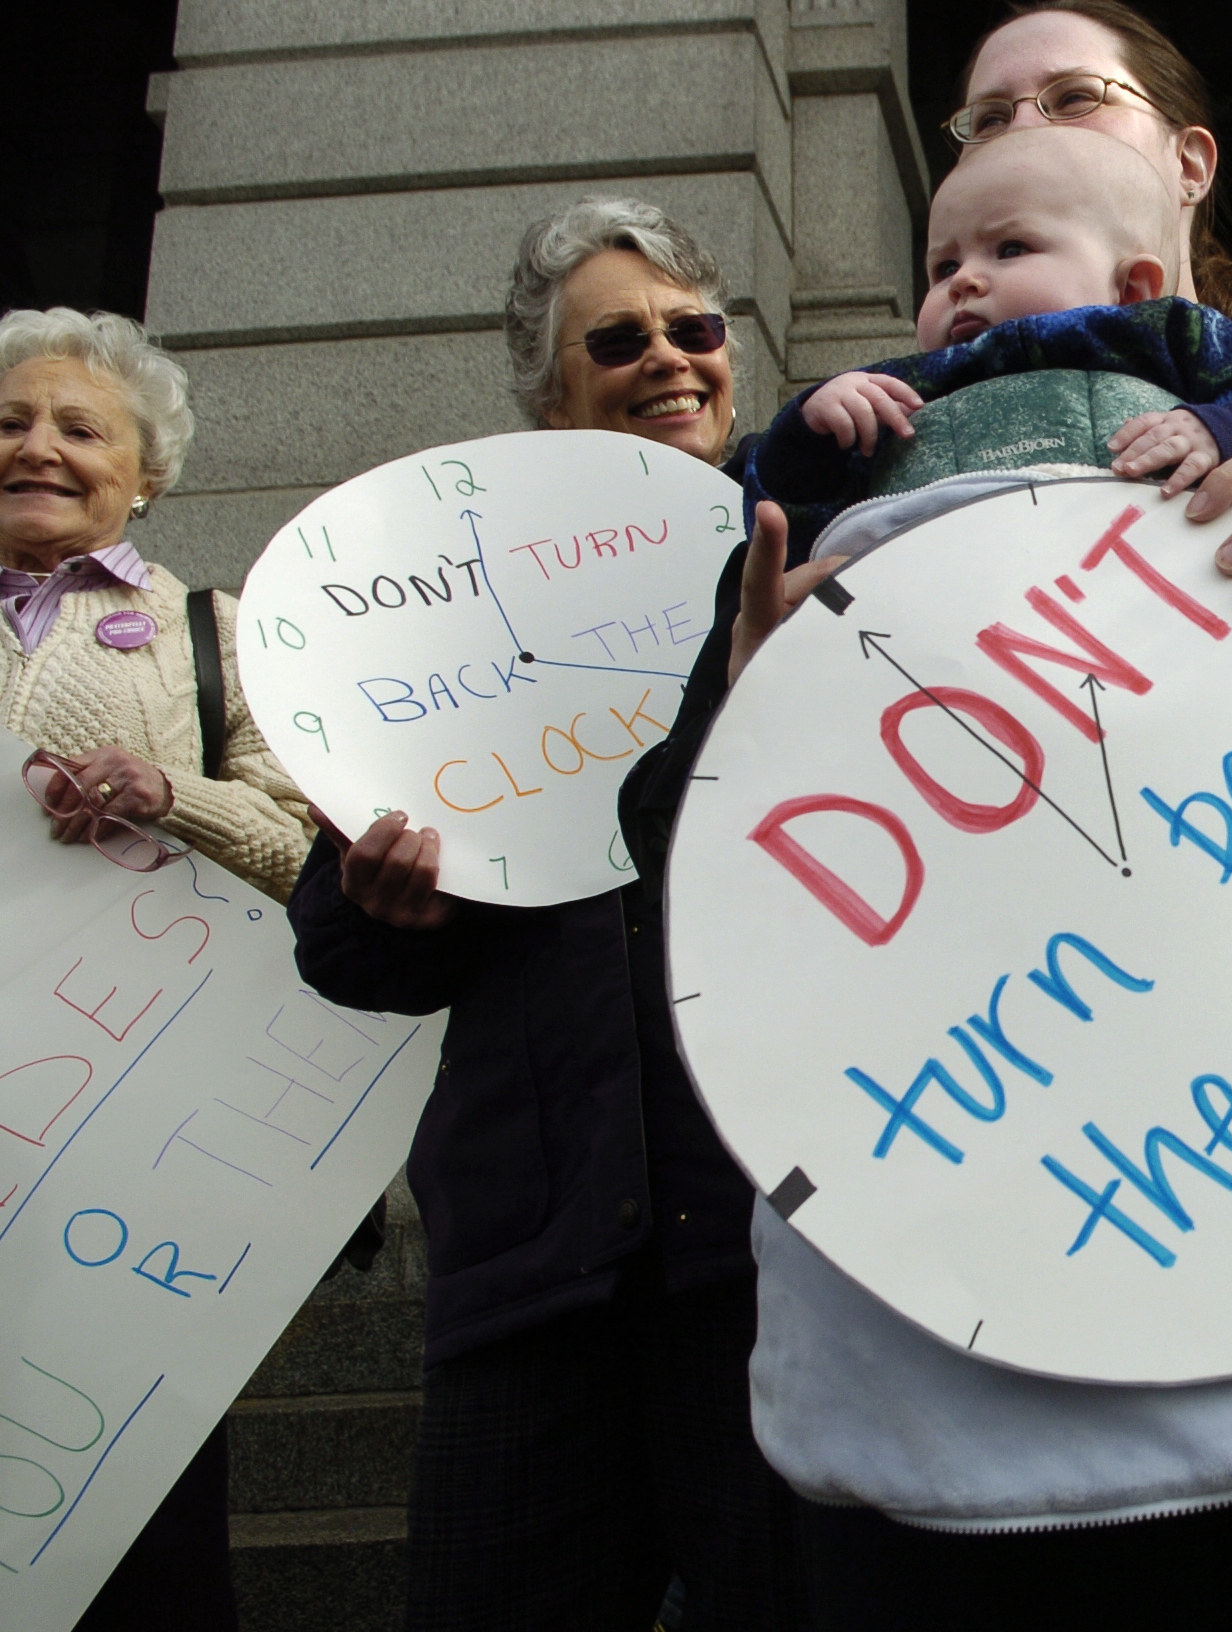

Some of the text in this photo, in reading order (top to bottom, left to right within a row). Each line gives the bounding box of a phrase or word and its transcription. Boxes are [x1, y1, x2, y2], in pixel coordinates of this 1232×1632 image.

[421, 460, 487, 501] 12
[638, 450, 649, 476] 1
[709, 505, 736, 533] 2
[297, 526, 337, 562] 11
[321, 519, 669, 617] DON'T TURN
[257, 616, 307, 650] 10
[357, 601, 710, 723] BACK THE
[293, 711, 331, 753] 9
[746, 504, 1231, 947] DON'T
[433, 688, 672, 814] CLOCK
[489, 856, 509, 890] 7
[843, 932, 1156, 1165] turn
[63, 1208, 217, 1298] OR
